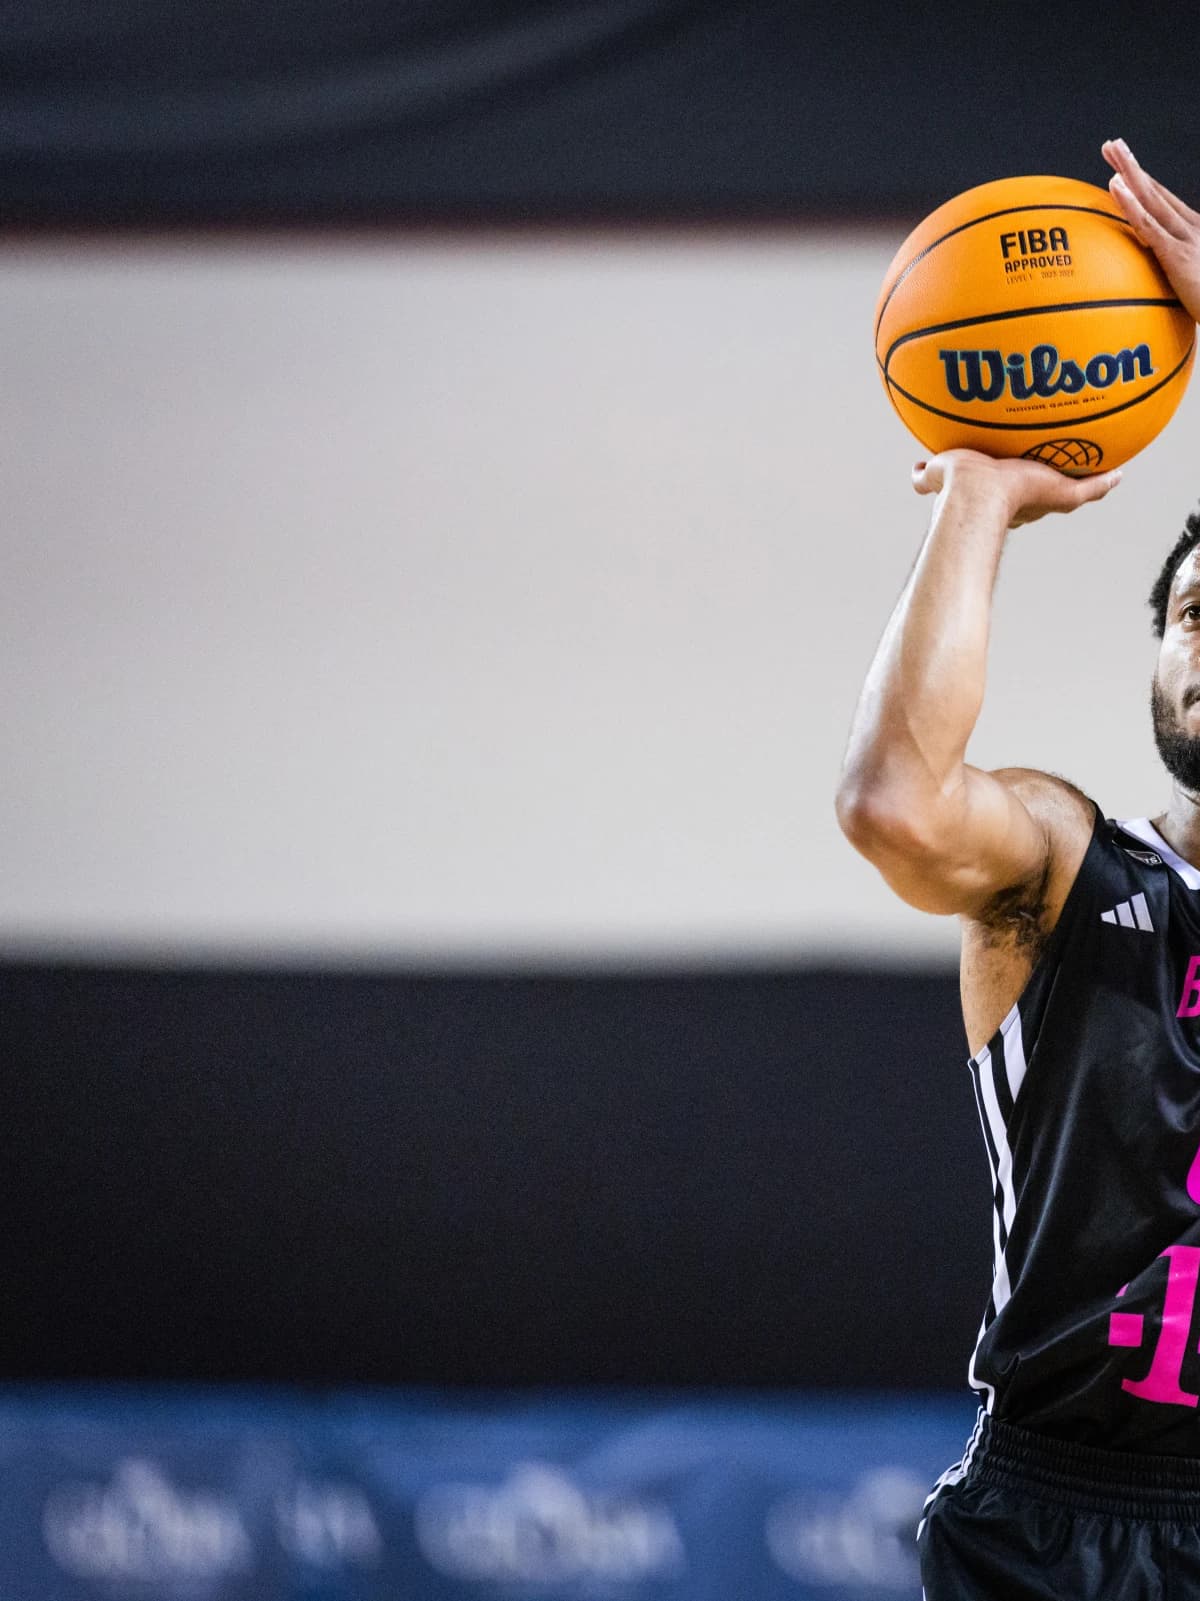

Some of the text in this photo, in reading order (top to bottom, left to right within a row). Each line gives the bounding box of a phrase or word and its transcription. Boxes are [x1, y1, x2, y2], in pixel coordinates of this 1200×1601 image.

[1000, 227, 1069, 258] FIBA
[1004, 254, 1072, 273] APPROVED
[939, 344, 1154, 402] Wilson
